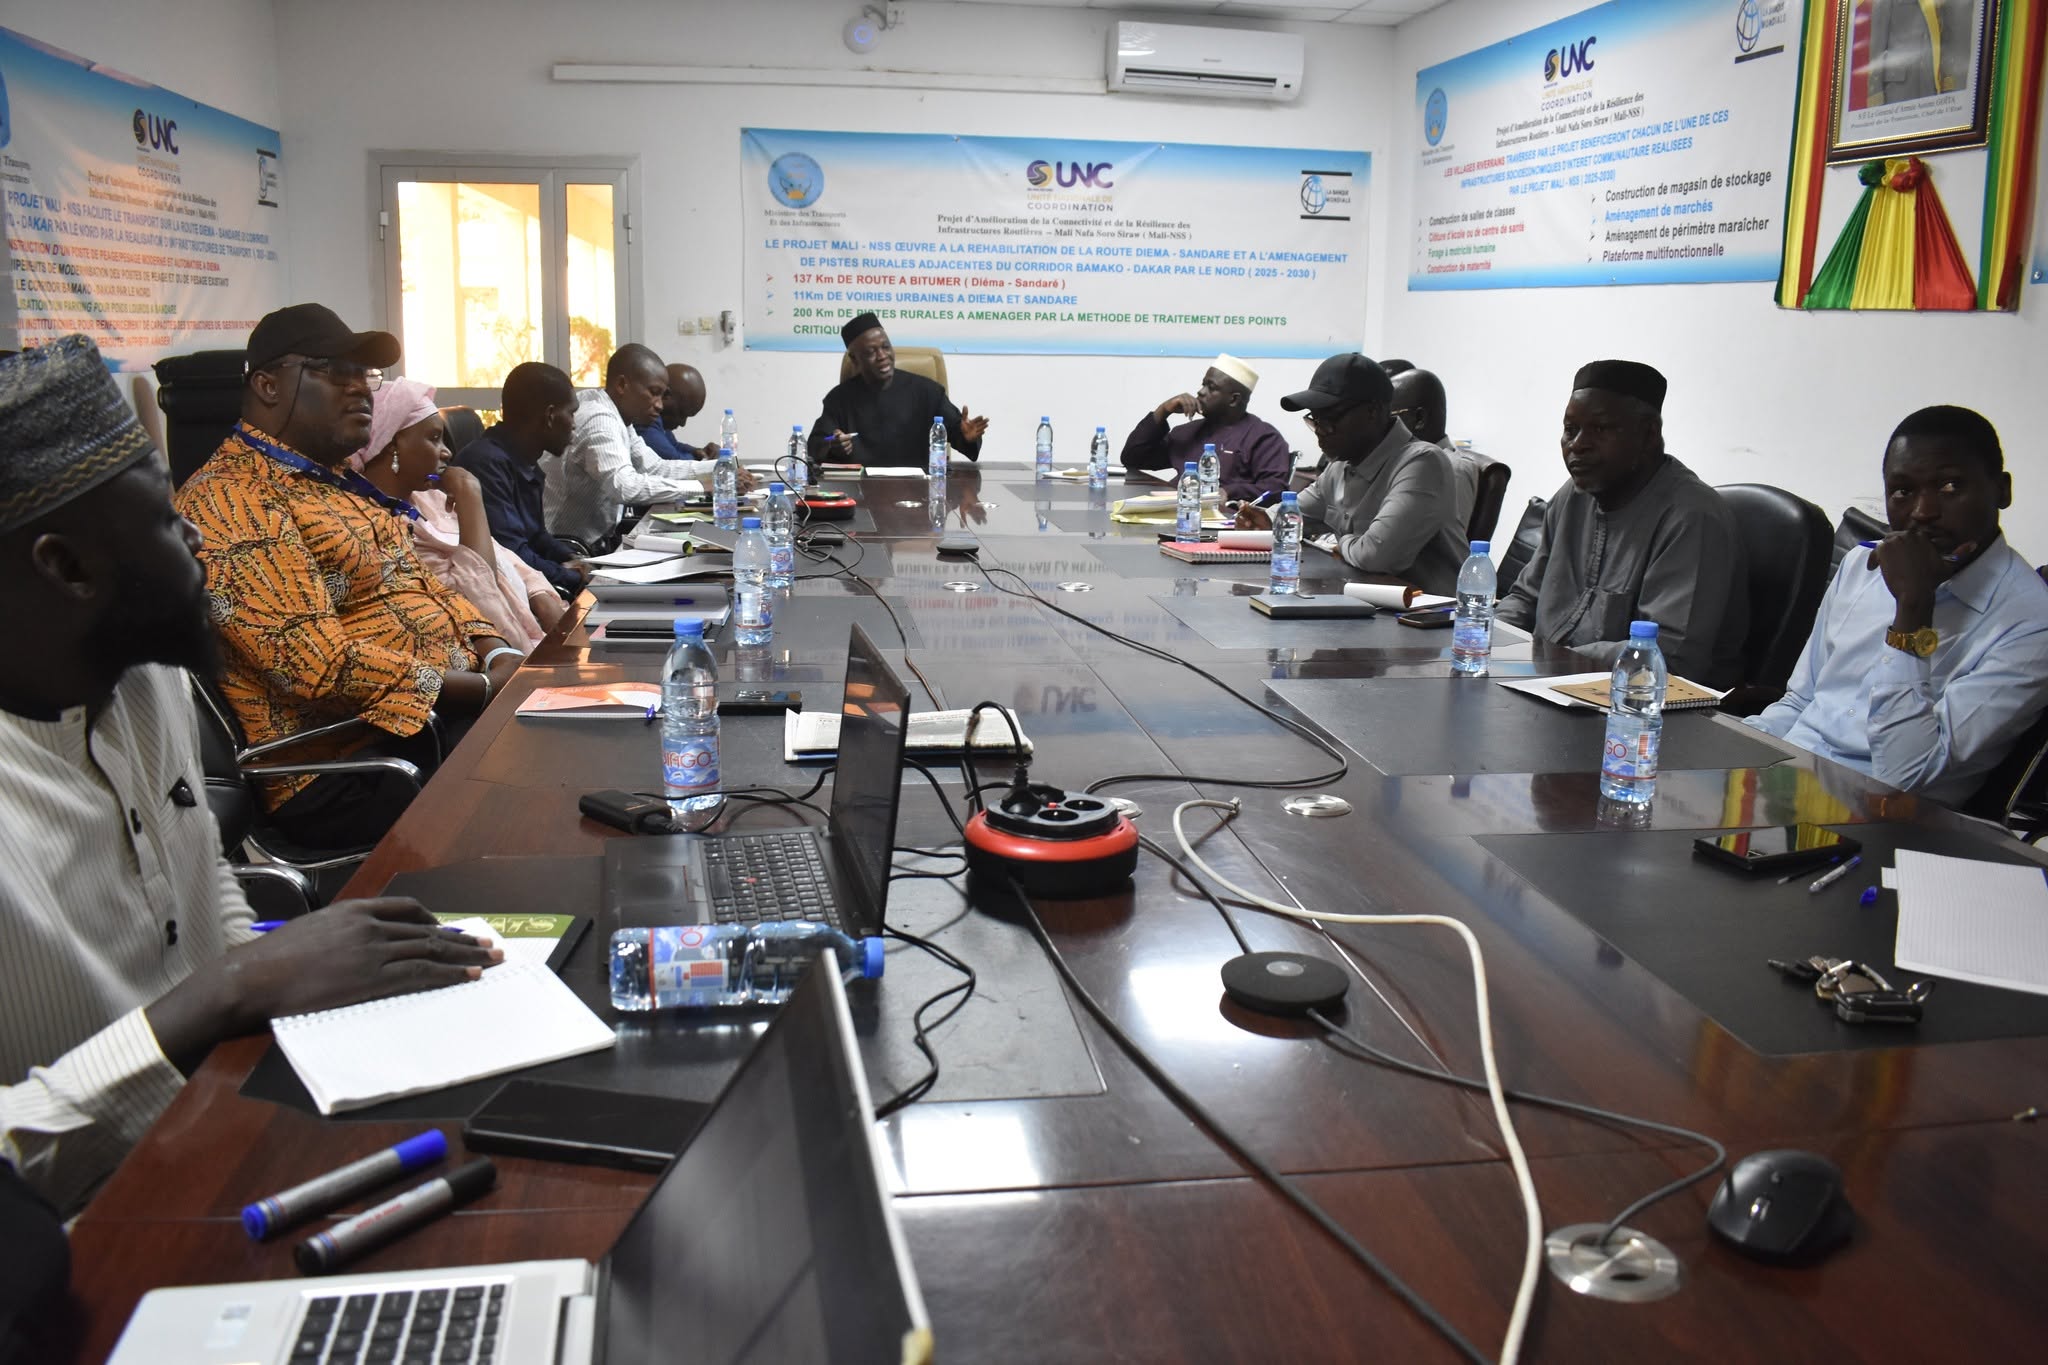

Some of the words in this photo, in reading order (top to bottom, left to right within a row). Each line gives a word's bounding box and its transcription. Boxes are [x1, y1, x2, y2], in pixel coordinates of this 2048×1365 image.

[1561, 36, 1597, 78] UNC
[1541, 91, 1592, 111] COORDINATION
[148, 113, 178, 155] UNC
[1631, 124, 1661, 142] CHACUN
[1662, 121, 1673, 136] DE
[1674, 116, 1697, 133] L'UNE
[1698, 114, 1710, 128] DE
[1712, 110, 1728, 126] CES
[1651, 137, 1692, 156] REALISEES
[1056, 161, 1113, 189] UNC
[1605, 184, 1655, 202] Construction
[1657, 183, 1668, 196] de
[1670, 178, 1707, 197] magasin
[1710, 176, 1722, 190] de
[1725, 170, 1771, 191] stockage
[7, 191, 44, 209] PROJET
[113, 209, 121, 221] LE
[1027, 202, 1113, 212] COORDINATION
[1604, 206, 1659, 225] Aménagement
[1660, 205, 1671, 217] de
[1673, 201, 1713, 216] marchés
[21, 215, 53, 233] DAKAR
[69, 222, 78, 236] LE
[100, 226, 113, 241] PAR
[115, 228, 123, 242] LA
[937, 214, 963, 226] Projet
[1029, 217, 1040, 225] de
[1041, 217, 1050, 225] la
[1051, 218, 1102, 227] Connectivité
[1103, 219, 1112, 227] et
[1113, 219, 1124, 227] de
[1125, 219, 1133, 228] la
[1135, 220, 1175, 229] Résilience
[1176, 221, 1191, 229] des
[937, 225, 1001, 235] Infrastructures
[1002, 227, 1043, 236] Routières
[1053, 228, 1073, 237] Mali
[1074, 228, 1094, 237] Nafa
[1096, 229, 1116, 238] Soro
[1116, 229, 1140, 238] Siraw
[1148, 230, 1186, 239] Mali-NSS
[1605, 226, 1657, 245] Aménagement
[1659, 226, 1669, 238] de
[1672, 222, 1715, 240] périmètre
[1718, 218, 1769, 234] maraîcher
[764, 239, 779, 249] LE
[782, 240, 828, 250] PROJET
[830, 240, 859, 251] MALI
[868, 241, 891, 251] NSS
[894, 242, 936, 252] ŒUVRE
[938, 243, 947, 252] A
[949, 243, 965, 253] LA
[967, 243, 1057, 255] REHABILITATION
[1060, 245, 1075, 255] DE
[1078, 246, 1093, 256] LA
[1095, 246, 1132, 257] ROUTE
[1135, 247, 1170, 258] DIEMA
[1178, 248, 1230, 259] SANDARE
[1232, 250, 1247, 260] ET
[1248, 251, 1257, 260] A
[1258, 251, 1348, 263] L'AMENAGEMENT
[1602, 249, 1643, 262] Plateforme
[1645, 244, 1724, 260] multifonctionnelle
[799, 257, 816, 267] DE
[818, 257, 859, 268] PISTES
[861, 258, 916, 269] RURALES
[917, 260, 993, 270] ADJACENTES
[995, 261, 1012, 271] DU
[1013, 262, 1073, 272] CORRIDOR
[1075, 263, 1124, 273] BAMAKO
[1132, 264, 1171, 274] DAKAR
[1173, 265, 1195, 275] PAR
[1198, 266, 1211, 275] LE
[1214, 266, 1245, 276] NORD
[1254, 267, 1278, 277] 2025
[1286, 268, 1310, 278] 2030
[793, 274, 812, 284] 137
[815, 274, 834, 284] Km
[836, 274, 852, 284] DE
[856, 275, 896, 285] ROUTE
[898, 275, 907, 285] A
[909, 276, 961, 287] BITUMER
[971, 277, 1005, 287] Diéma
[1014, 278, 1059, 289] Sandaré
[793, 291, 824, 301] 11Km
[826, 291, 843, 301] DE
[845, 292, 892, 302] VOIRIES
[895, 293, 954, 303] URBAINES
[956, 294, 965, 303] A
[967, 294, 1004, 304] DIEMA
[1006, 295, 1020, 304] ET
[1023, 295, 1077, 305] SANDARE
[793, 308, 812, 318] 200
[815, 308, 834, 318] Km
[837, 308, 853, 318] DE
[899, 309, 954, 319] RURALES
[956, 310, 965, 320] A
[967, 310, 1031, 321] AMENAGER
[1034, 311, 1057, 321] PAR
[1060, 312, 1074, 321] LA
[1077, 312, 1130, 322] METHODE
[1134, 313, 1148, 323] DE
[1153, 313, 1220, 324] TRAITEMENT
[1223, 315, 1245, 325] DES
[1248, 315, 1287, 326] POINTS
[793, 325, 843, 336] CRITIQU
